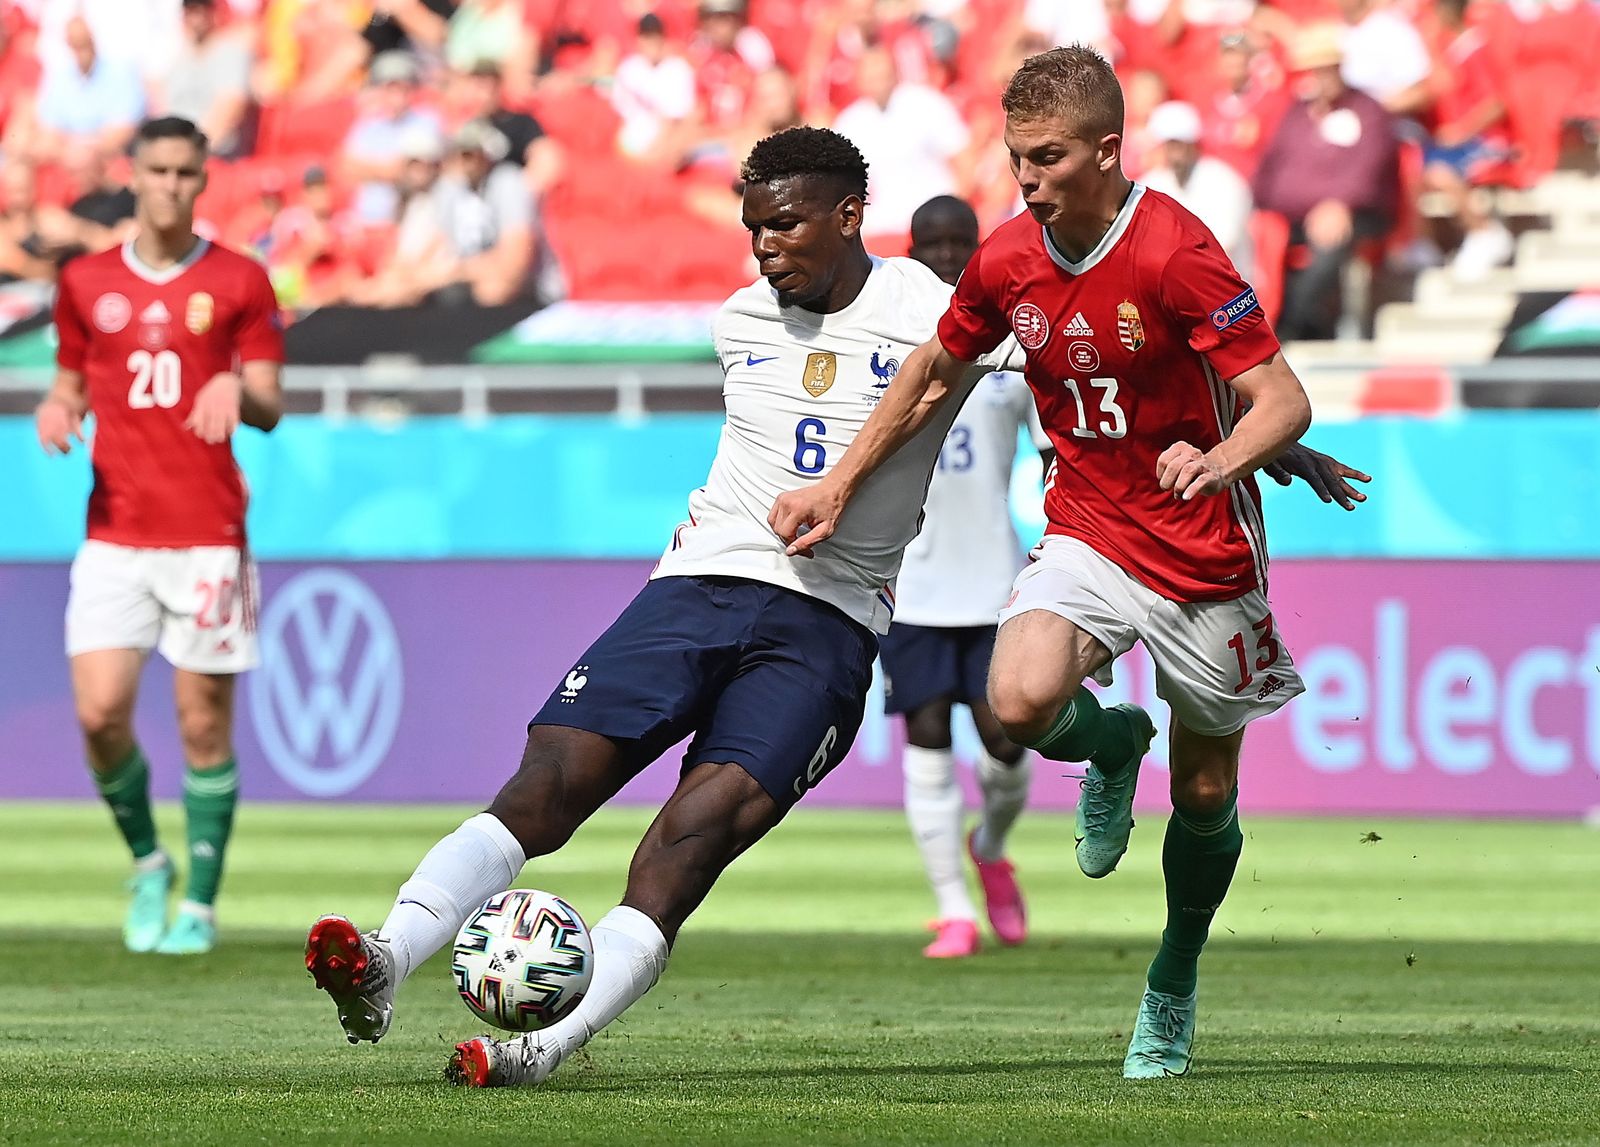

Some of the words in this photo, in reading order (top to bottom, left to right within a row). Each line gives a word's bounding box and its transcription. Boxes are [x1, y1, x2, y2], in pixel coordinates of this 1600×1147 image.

[1063, 328, 1094, 336] adidas
[1227, 291, 1256, 318] RESPECT
[127, 349, 182, 410] 20
[1063, 377, 1127, 439] 13
[793, 417, 826, 474] 6
[194, 577, 235, 630] 20
[1228, 612, 1279, 694] 13
[1257, 679, 1286, 701] adidas
[807, 725, 838, 783] 6
